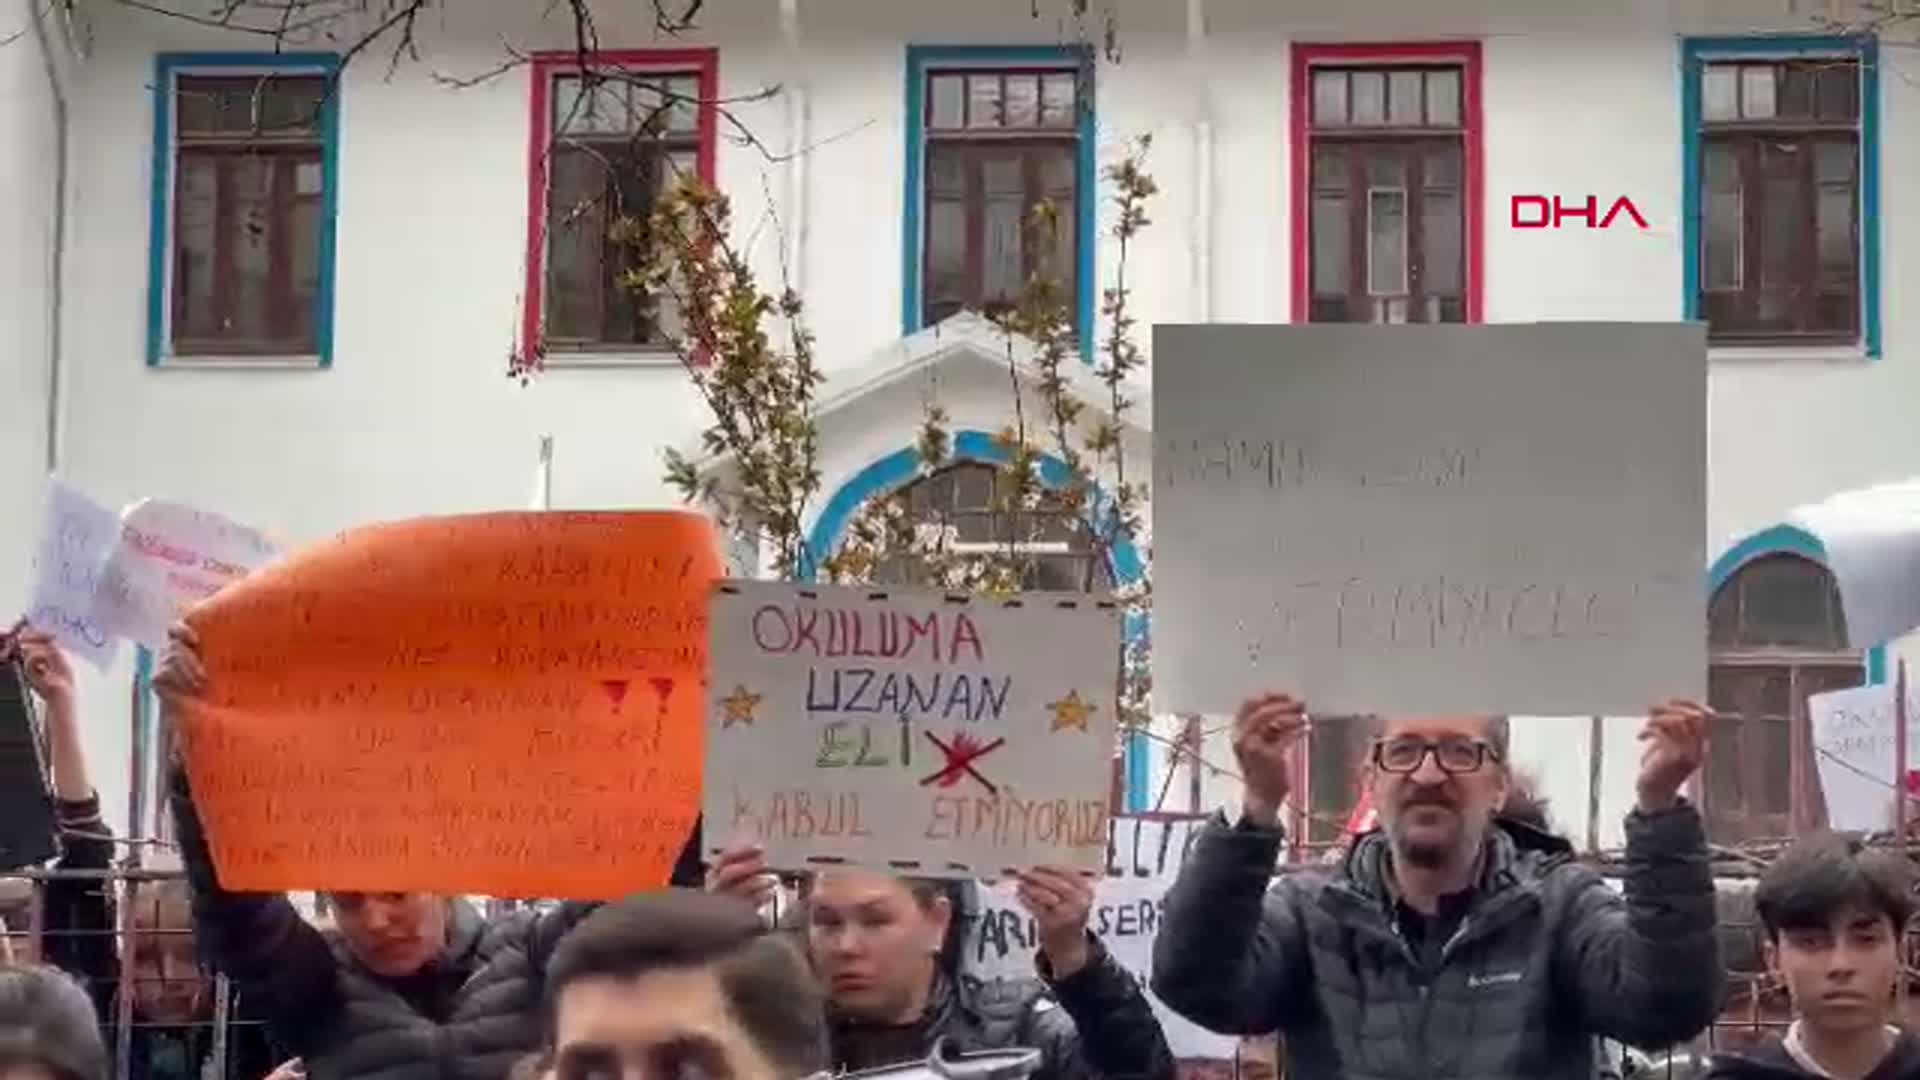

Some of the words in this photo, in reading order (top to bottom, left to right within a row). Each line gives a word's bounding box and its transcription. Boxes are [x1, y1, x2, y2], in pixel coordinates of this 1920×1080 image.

[752, 604, 984, 665] OKULUMA
[806, 667, 1012, 721] UZANAN
[730, 784, 873, 838] KABUL
